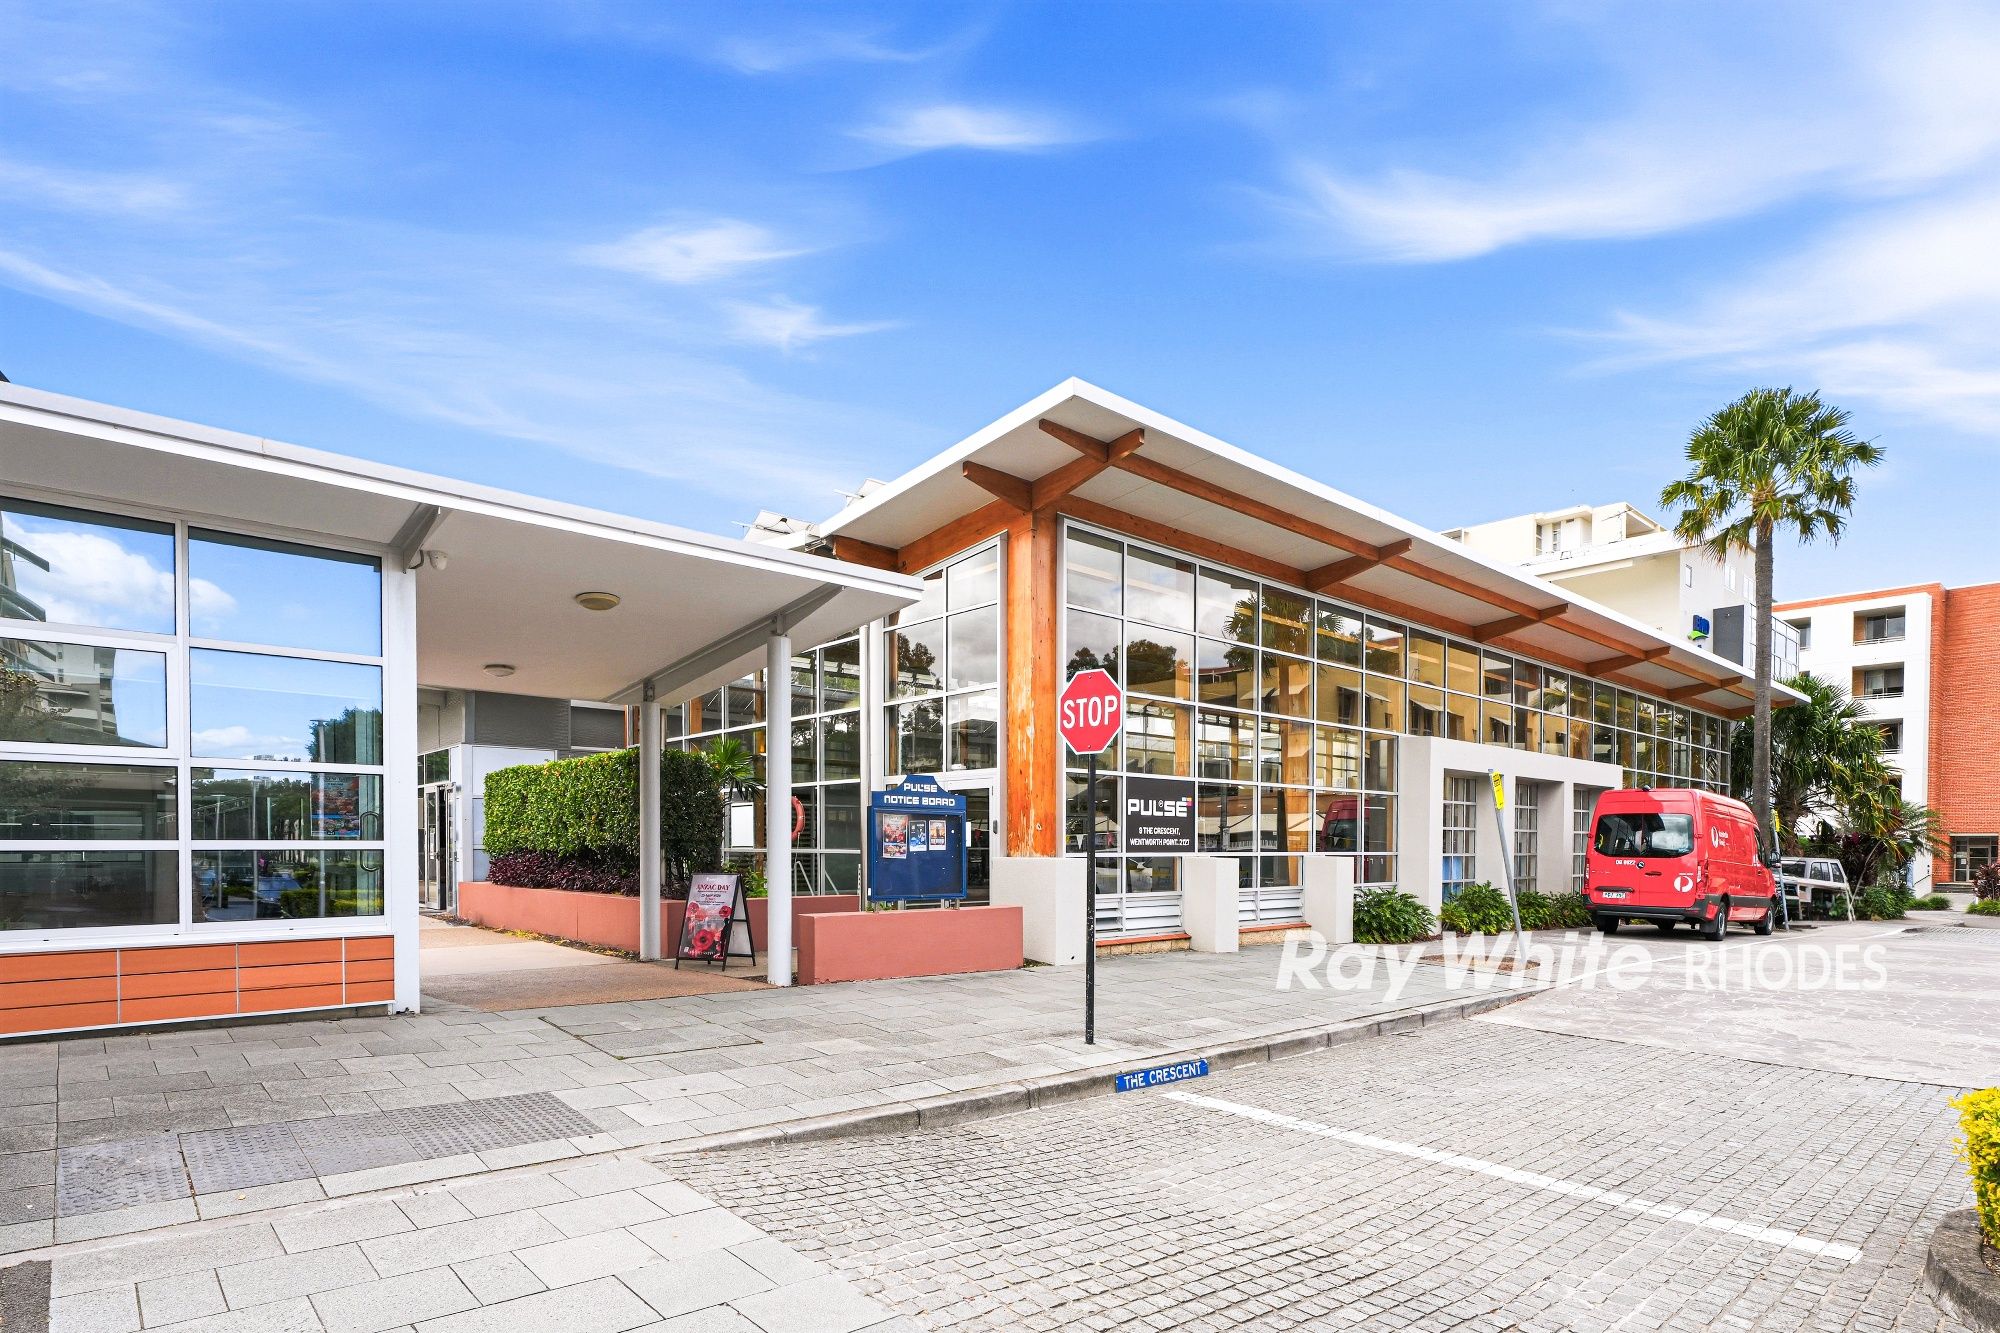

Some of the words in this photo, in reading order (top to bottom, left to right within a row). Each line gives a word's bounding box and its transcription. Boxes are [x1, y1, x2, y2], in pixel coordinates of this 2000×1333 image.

[1062, 694, 1118, 729] STOP
[904, 783, 938, 792] PULSE
[884, 795, 920, 804] NOTICE
[922, 797, 956, 806] BOARD
[1127, 798, 1188, 818] PULSE
[1143, 826, 1154, 835] THE
[1153, 826, 1181, 836] CRESCENT,
[1129, 838, 1163, 846] WENTWORTH
[1123, 1072, 1146, 1089] THE
[1159, 1061, 1202, 1084] CRESCENT
